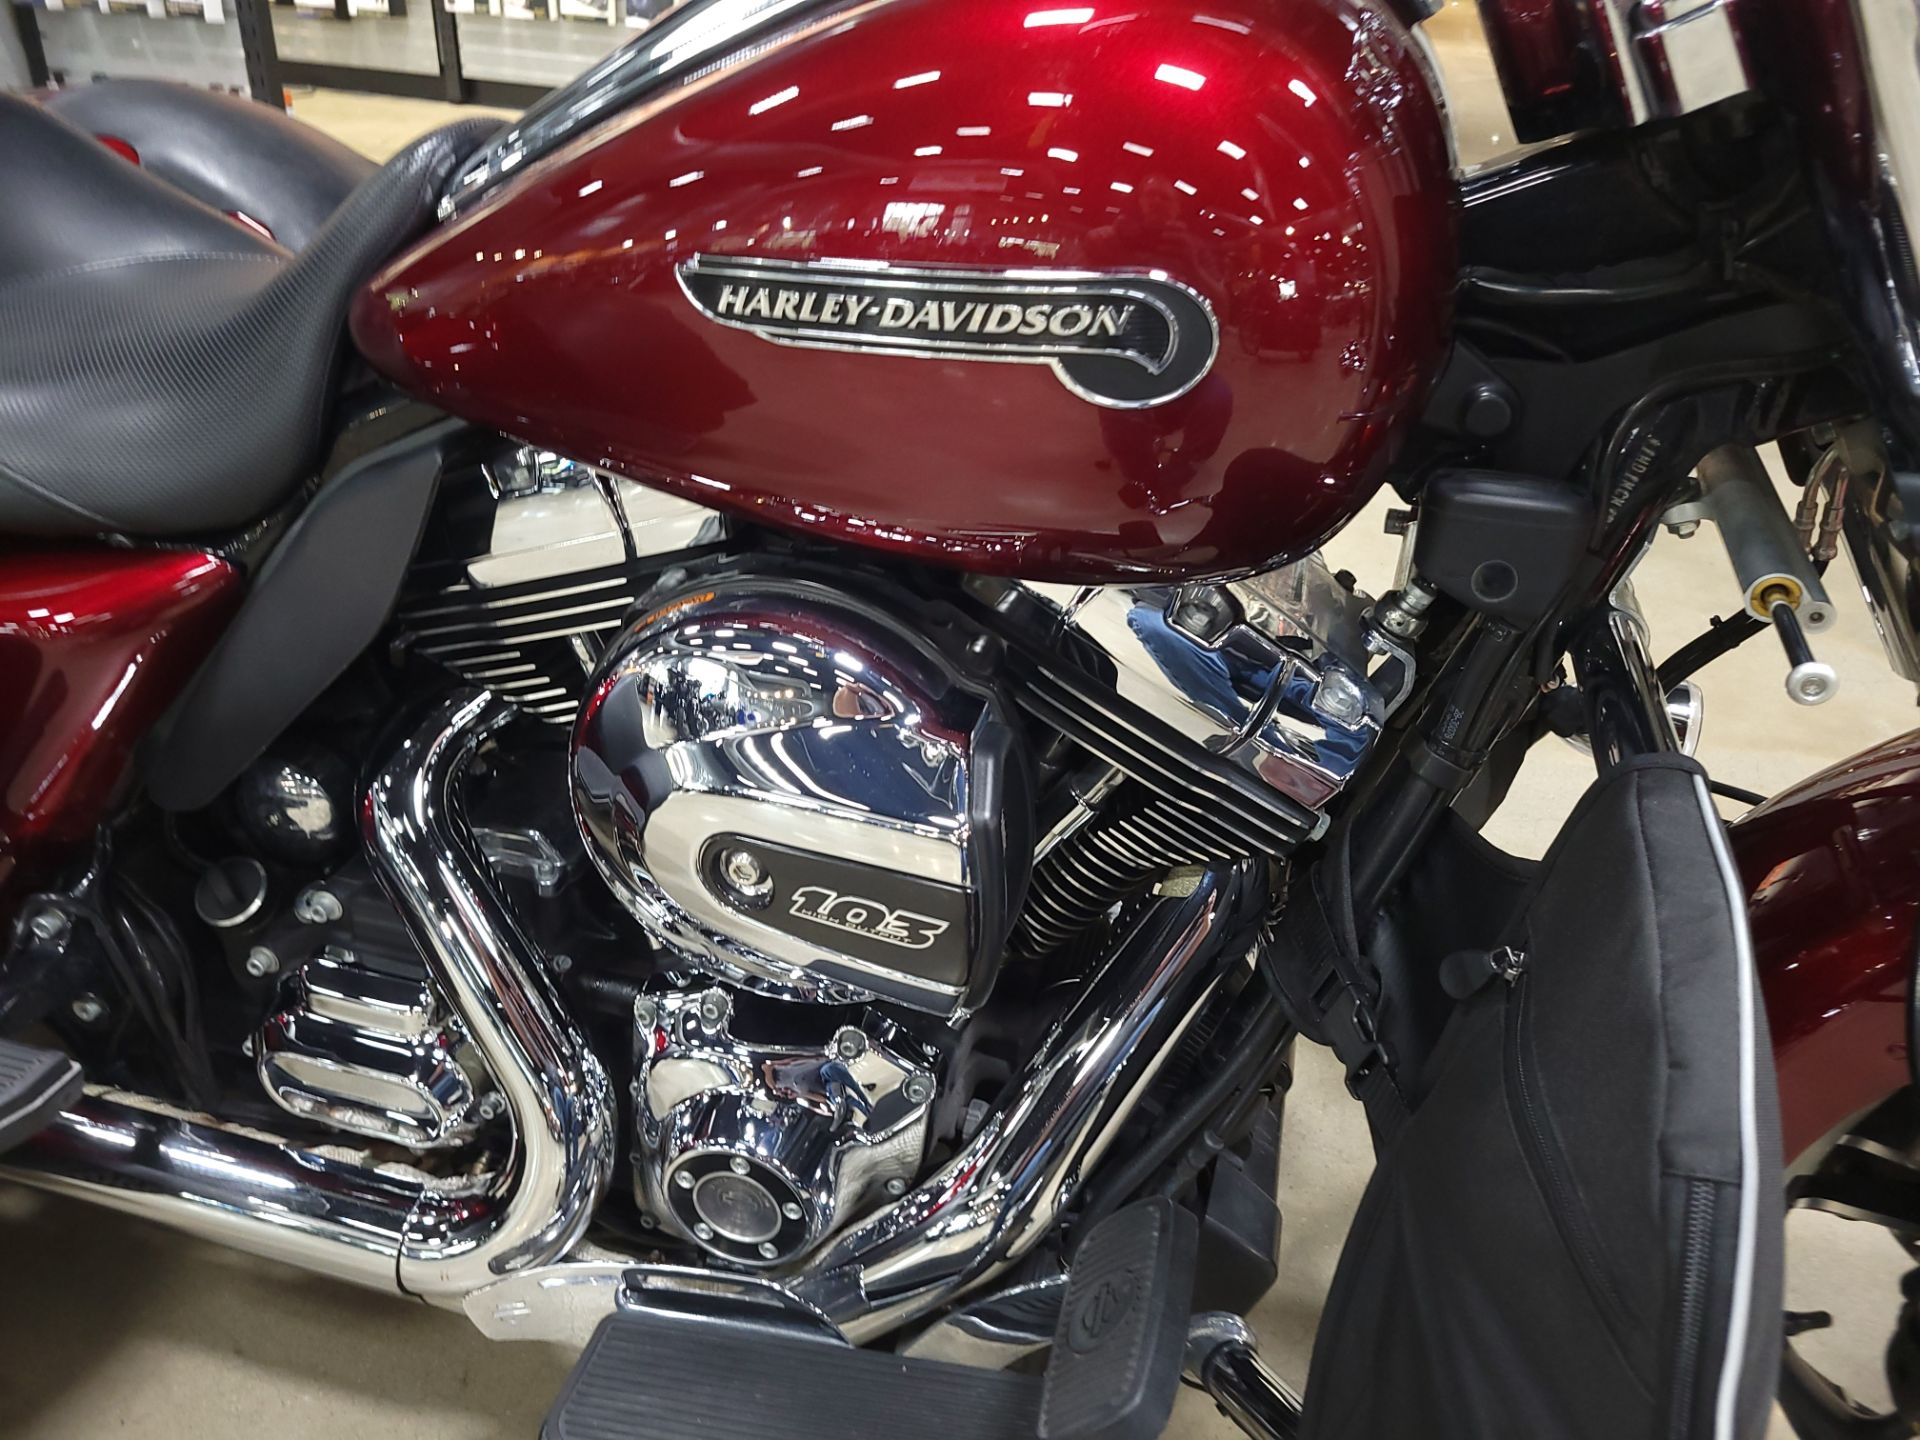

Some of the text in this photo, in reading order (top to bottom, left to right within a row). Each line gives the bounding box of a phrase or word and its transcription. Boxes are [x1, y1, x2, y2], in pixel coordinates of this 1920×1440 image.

[717, 285, 1134, 337] HARLEY-DAVIDSON
[789, 886, 950, 949] 103
[801, 909, 913, 944] HIGH OUTPUT
